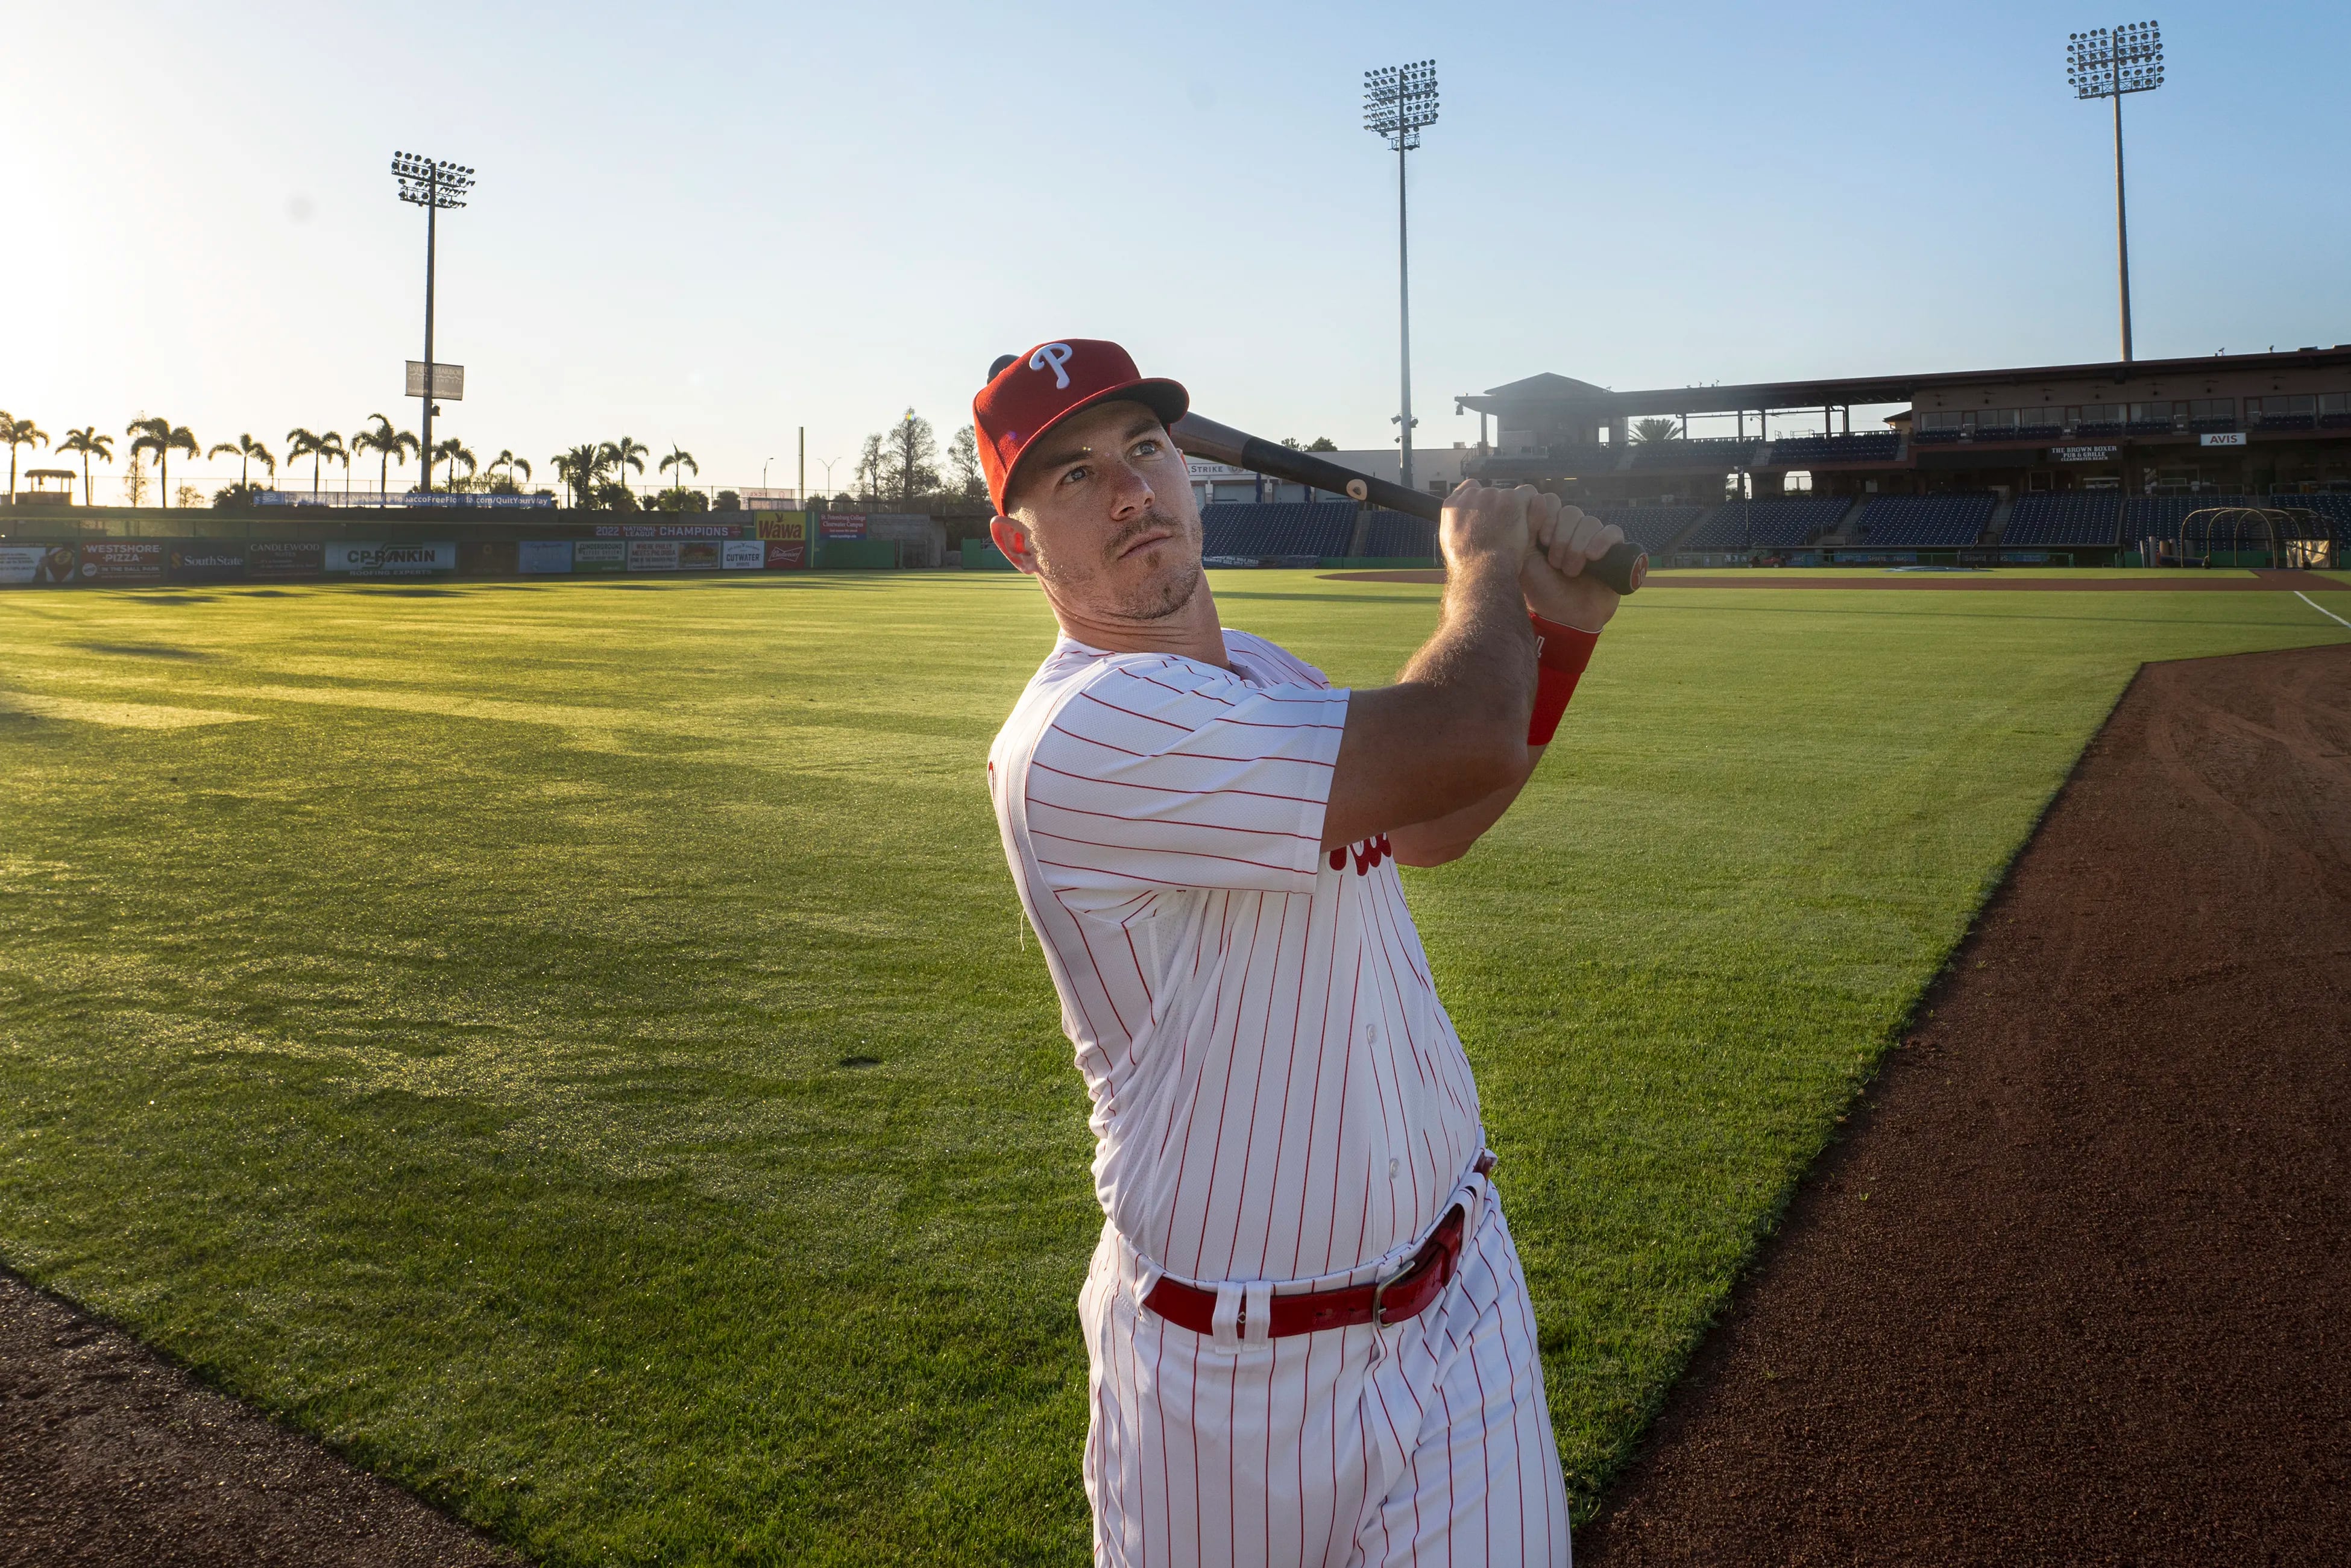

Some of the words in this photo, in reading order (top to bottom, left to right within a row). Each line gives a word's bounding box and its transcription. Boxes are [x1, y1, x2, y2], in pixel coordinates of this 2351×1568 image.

[1029, 342, 1072, 390] P
[435, 367, 463, 376] HARBOR
[2210, 435, 2238, 444] AVIS
[596, 526, 620, 536] 2022
[660, 526, 728, 536] CHAMPIONS
[758, 520, 802, 538] Wawa
[184, 555, 244, 565] SouthState
